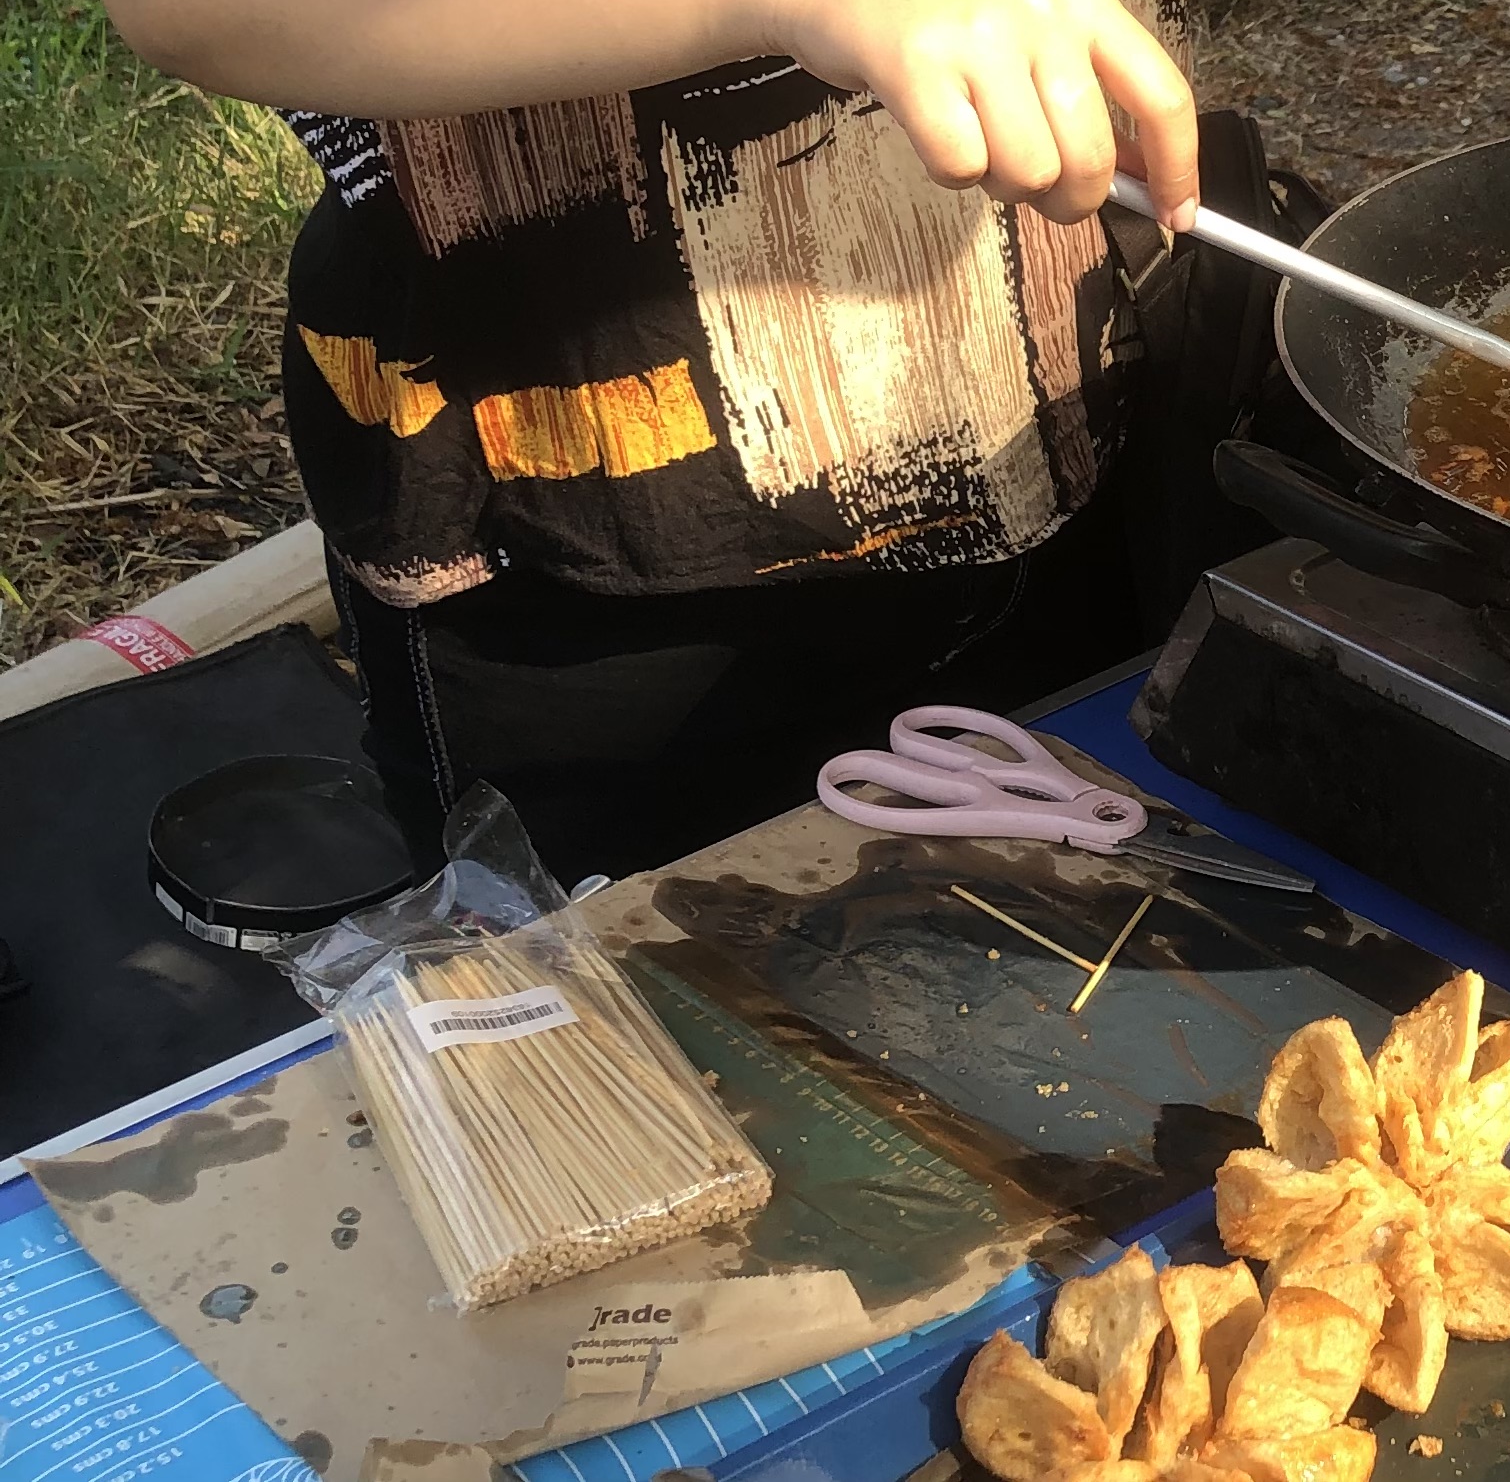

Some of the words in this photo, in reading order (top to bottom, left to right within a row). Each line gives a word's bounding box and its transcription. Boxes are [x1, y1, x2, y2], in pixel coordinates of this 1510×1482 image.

[832, 1110, 851, 1125] 11
[849, 1124, 870, 1140] 12
[868, 1137, 889, 1154] 13
[13, 1320, 59, 1345] 30.5
[32, 1340, 79, 1365] 27.9
[0, 1361, 30, 1383] cm
[52, 1360, 99, 1386] 25.4
[10, 1382, 50, 1408] cms
[74, 1381, 120, 1407] 22.9
[30, 1403, 71, 1429] cms
[95, 1403, 141, 1429] 20.3
[51, 1425, 92, 1451] cms
[116, 1426, 162, 1451] 17.8
[72, 1447, 113, 1473] cms
[138, 1447, 184, 1475] 15.2
